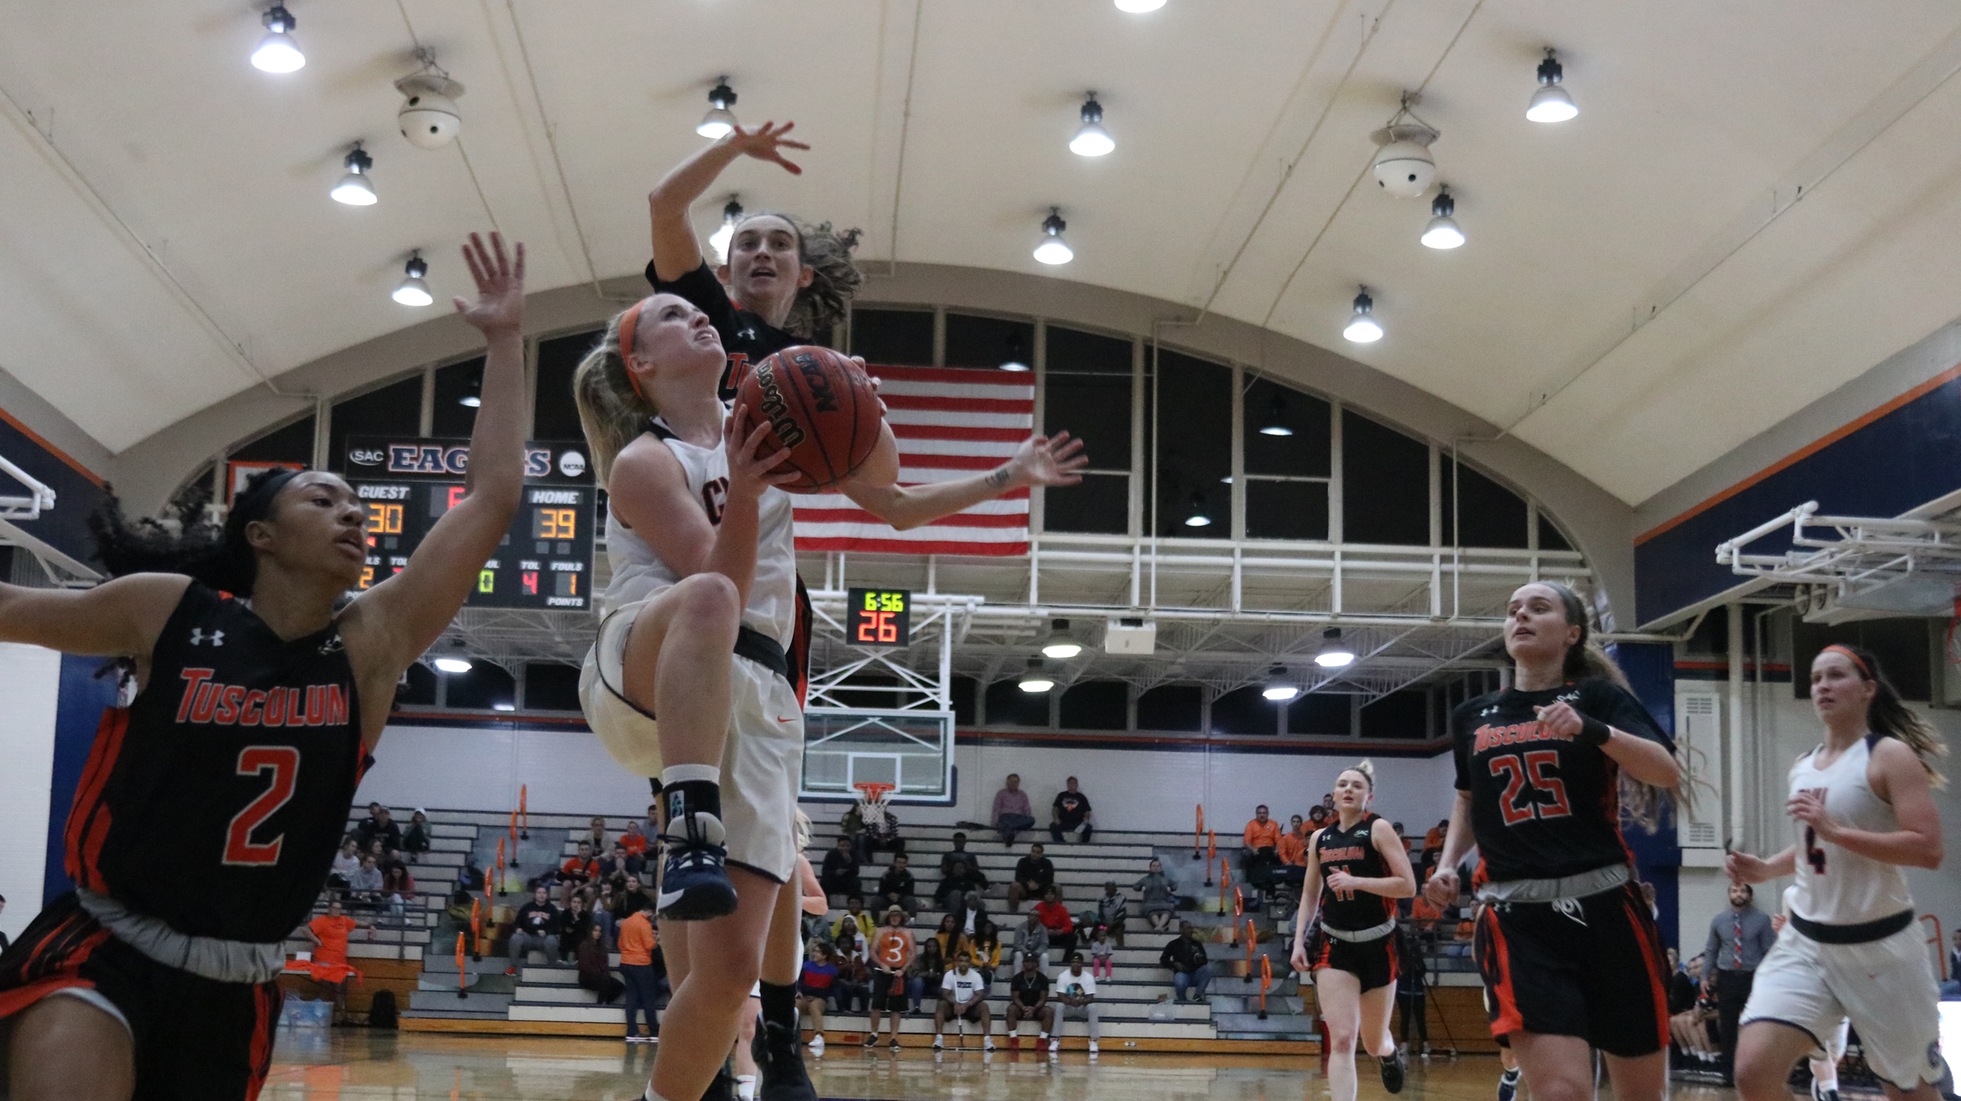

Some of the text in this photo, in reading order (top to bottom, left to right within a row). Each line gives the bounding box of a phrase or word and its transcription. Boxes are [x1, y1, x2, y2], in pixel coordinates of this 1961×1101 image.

[354, 450, 384, 462] SAC
[388, 445, 551, 477] EAGS
[358, 486, 410, 499] GUEST
[532, 491, 579, 504] HOME
[367, 502, 404, 534] 30
[539, 508, 576, 539] 39
[521, 560, 540, 570] TOL
[551, 561, 583, 571] FOULS
[359, 566, 375, 589] 2
[522, 571, 538, 594] 4
[547, 597, 584, 607] POINTS
[865, 592, 904, 612] 6:56
[858, 610, 898, 643] 26
[1472, 720, 1574, 756] TUSCULU
[1488, 750, 1572, 826] 25
[221, 745, 300, 867] 2
[886, 936, 904, 962] 3
